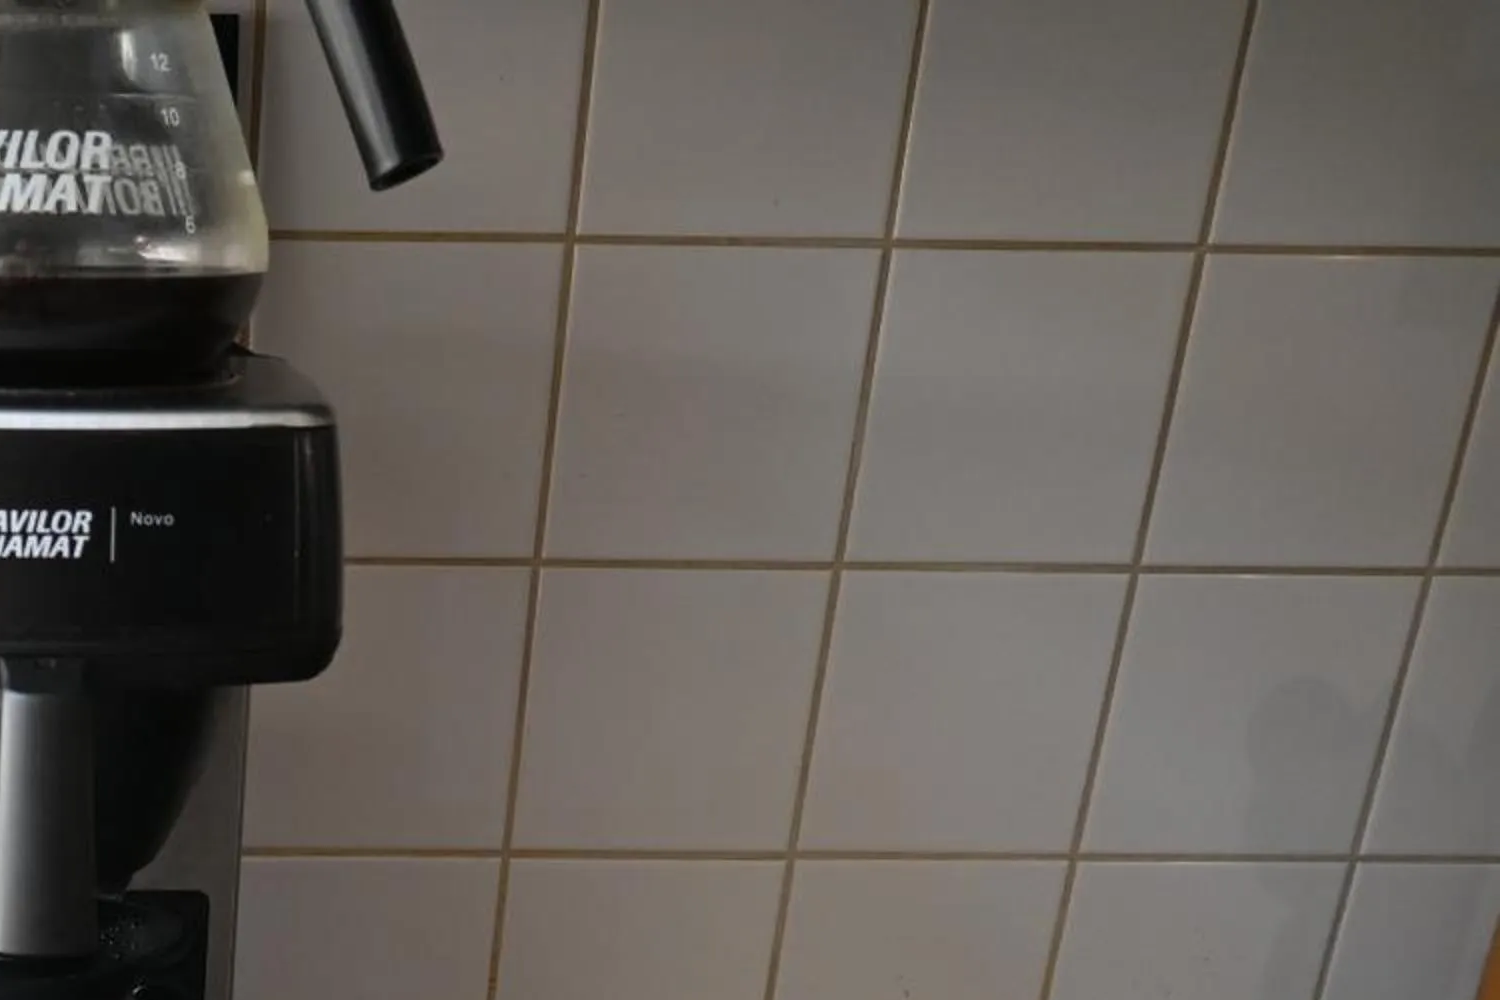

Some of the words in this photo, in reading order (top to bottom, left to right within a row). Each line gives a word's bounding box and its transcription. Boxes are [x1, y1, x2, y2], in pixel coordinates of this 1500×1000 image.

[150, 52, 171, 72] 12
[161, 107, 180, 127] 10
[130, 511, 175, 526] Novo
